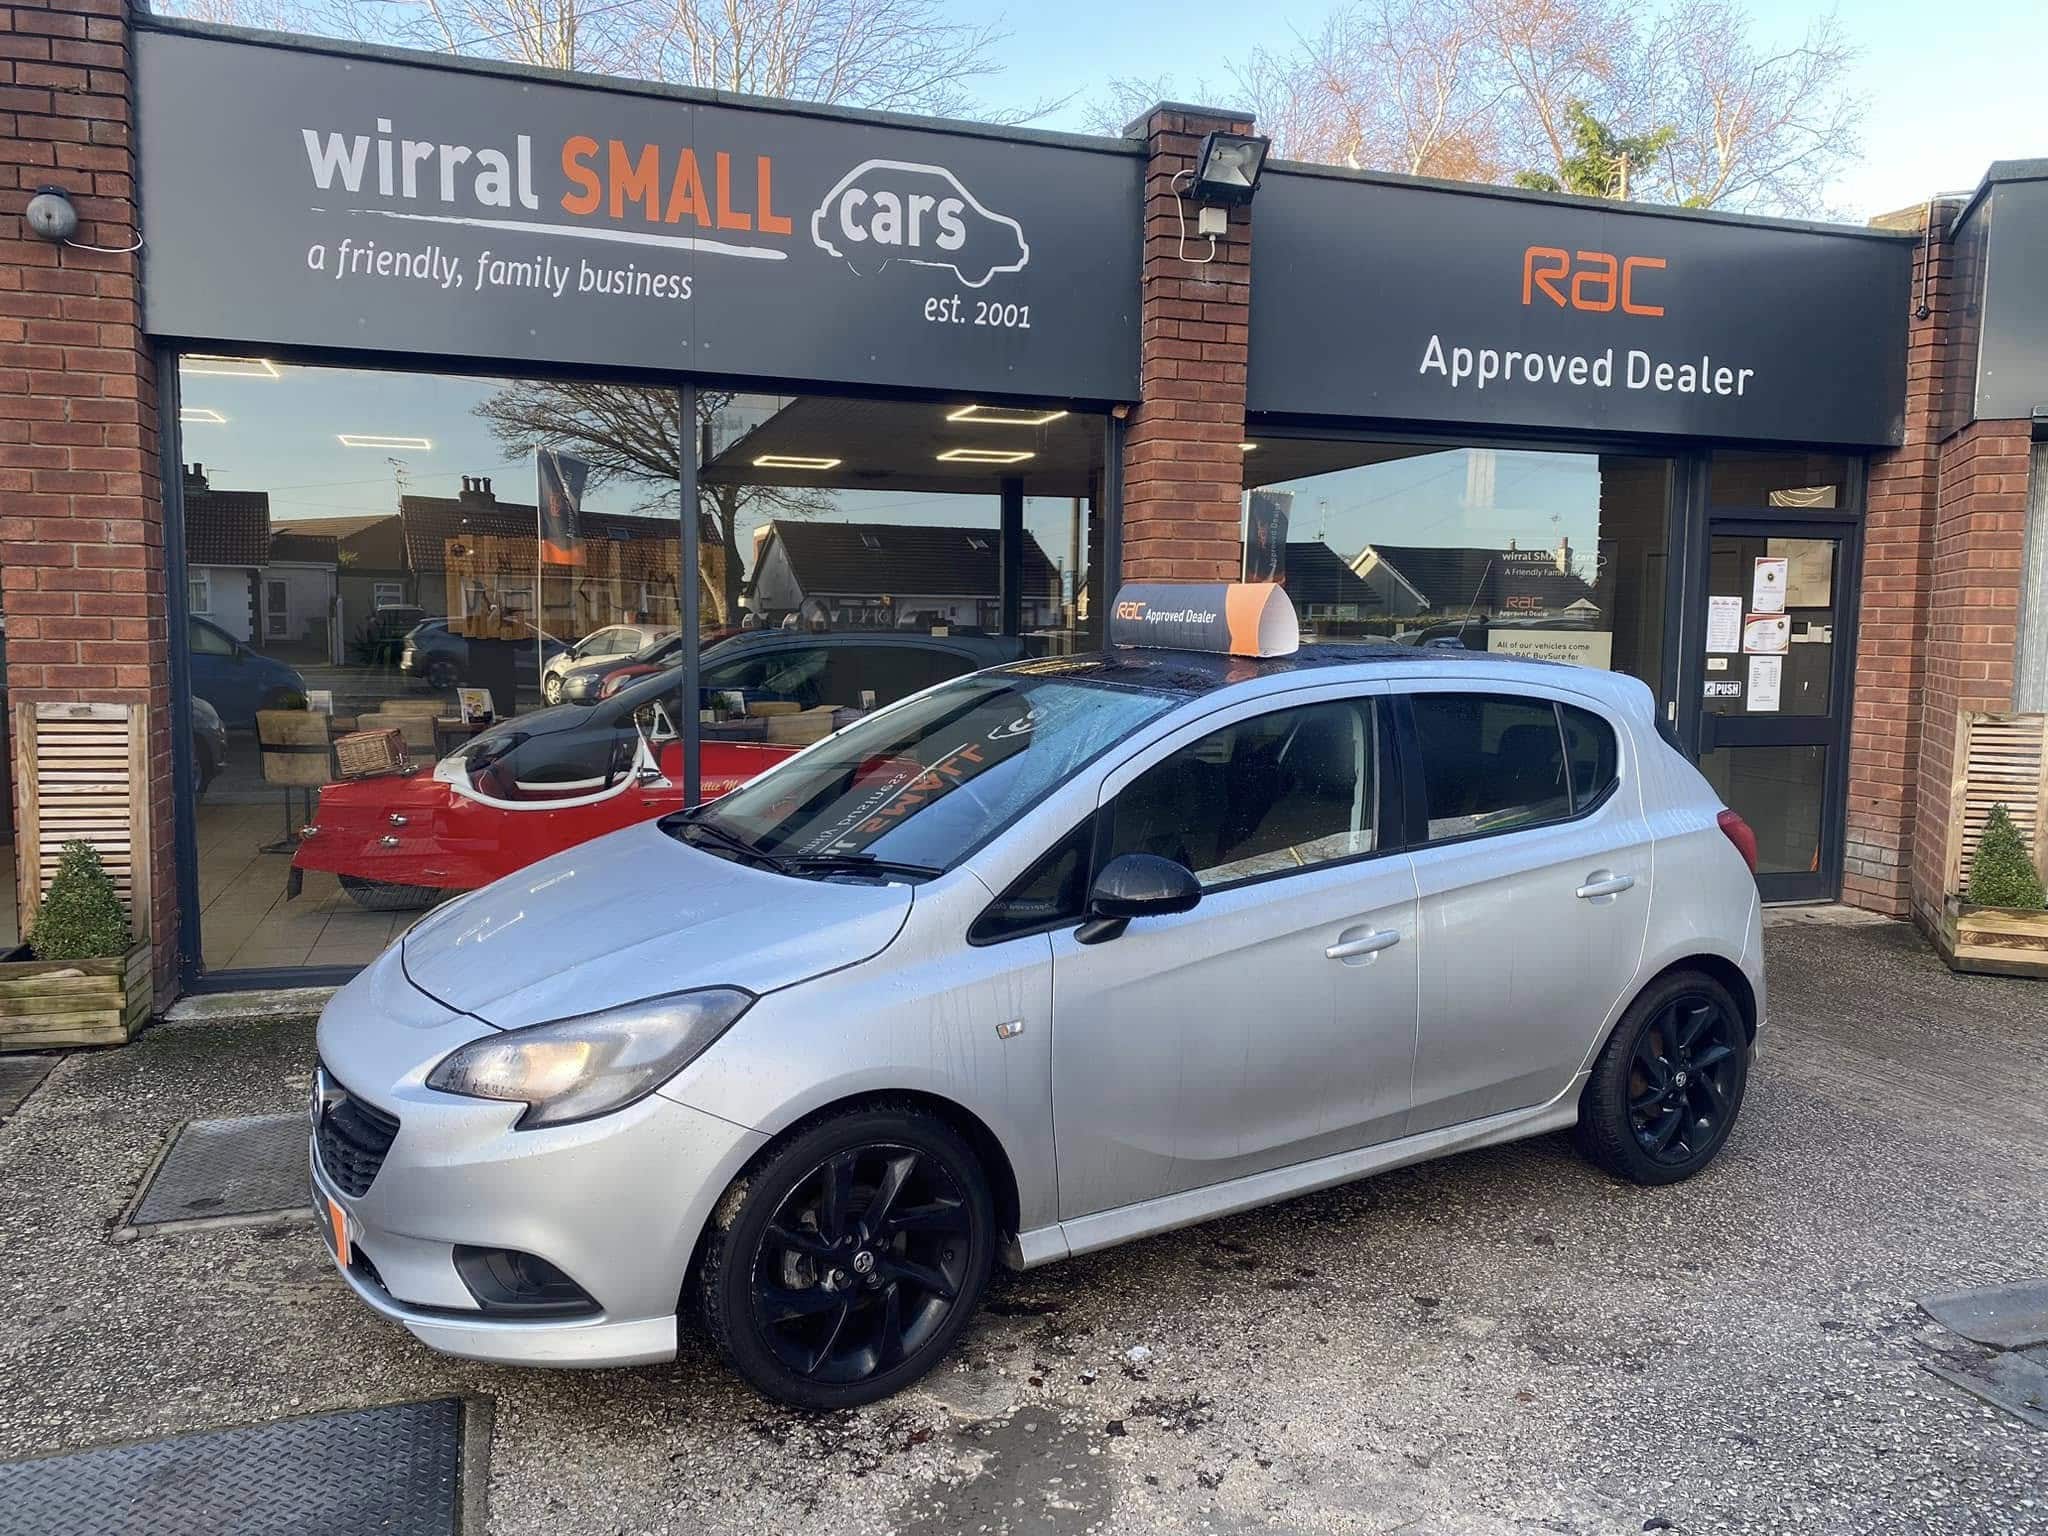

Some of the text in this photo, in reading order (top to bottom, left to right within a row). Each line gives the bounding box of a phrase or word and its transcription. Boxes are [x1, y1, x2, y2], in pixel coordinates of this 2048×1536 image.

[302, 118, 967, 251] wirral SMALL cars
[306, 238, 693, 300] a friendly, family business
[923, 294, 1032, 329] est. 2001
[1419, 335, 1755, 397] Approved Dealer
[1502, 551, 1531, 561] wirral
[1145, 609, 1184, 625] Approved
[1186, 610, 1216, 623] Dealer
[1497, 641, 1508, 649] All
[1510, 641, 1518, 649] of
[1534, 642, 1567, 651] vehicles
[1568, 643, 1590, 651] come
[1533, 652, 1567, 661] BuySure
[1716, 683, 1739, 695] PUSH
